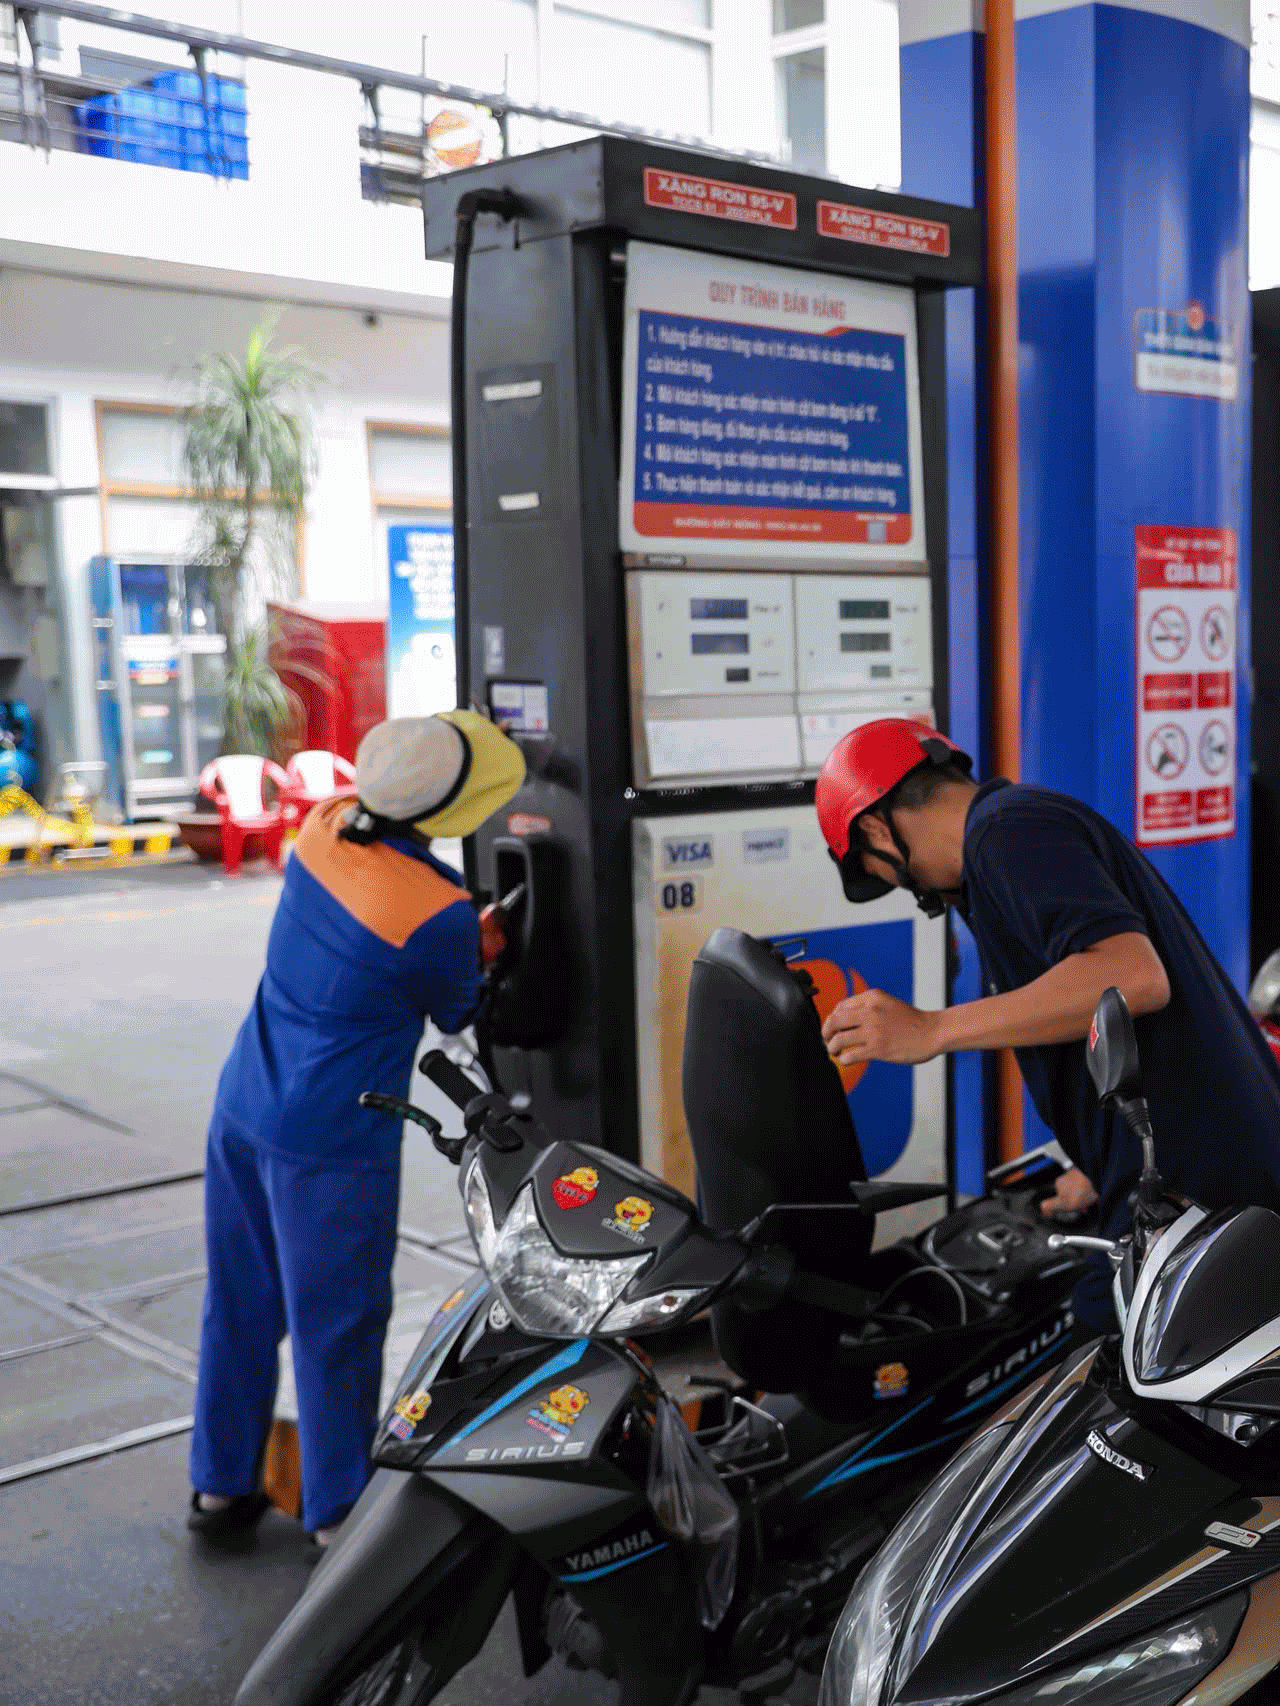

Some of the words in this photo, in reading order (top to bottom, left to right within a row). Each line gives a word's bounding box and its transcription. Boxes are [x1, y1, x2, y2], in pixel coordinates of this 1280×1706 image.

[708, 280, 736, 304] QUY
[740, 282, 779, 311] TRÌNH
[782, 288, 809, 315] BÁN
[811, 292, 845, 320] HÀNG
[664, 842, 713, 864] VISA
[663, 882, 694, 910] 08
[966, 1310, 1076, 1398] SIRIUS
[465, 1441, 586, 1462] SIRIUS
[1086, 1430, 1146, 1481] HONDA
[565, 1529, 655, 1571] YAMAHA
